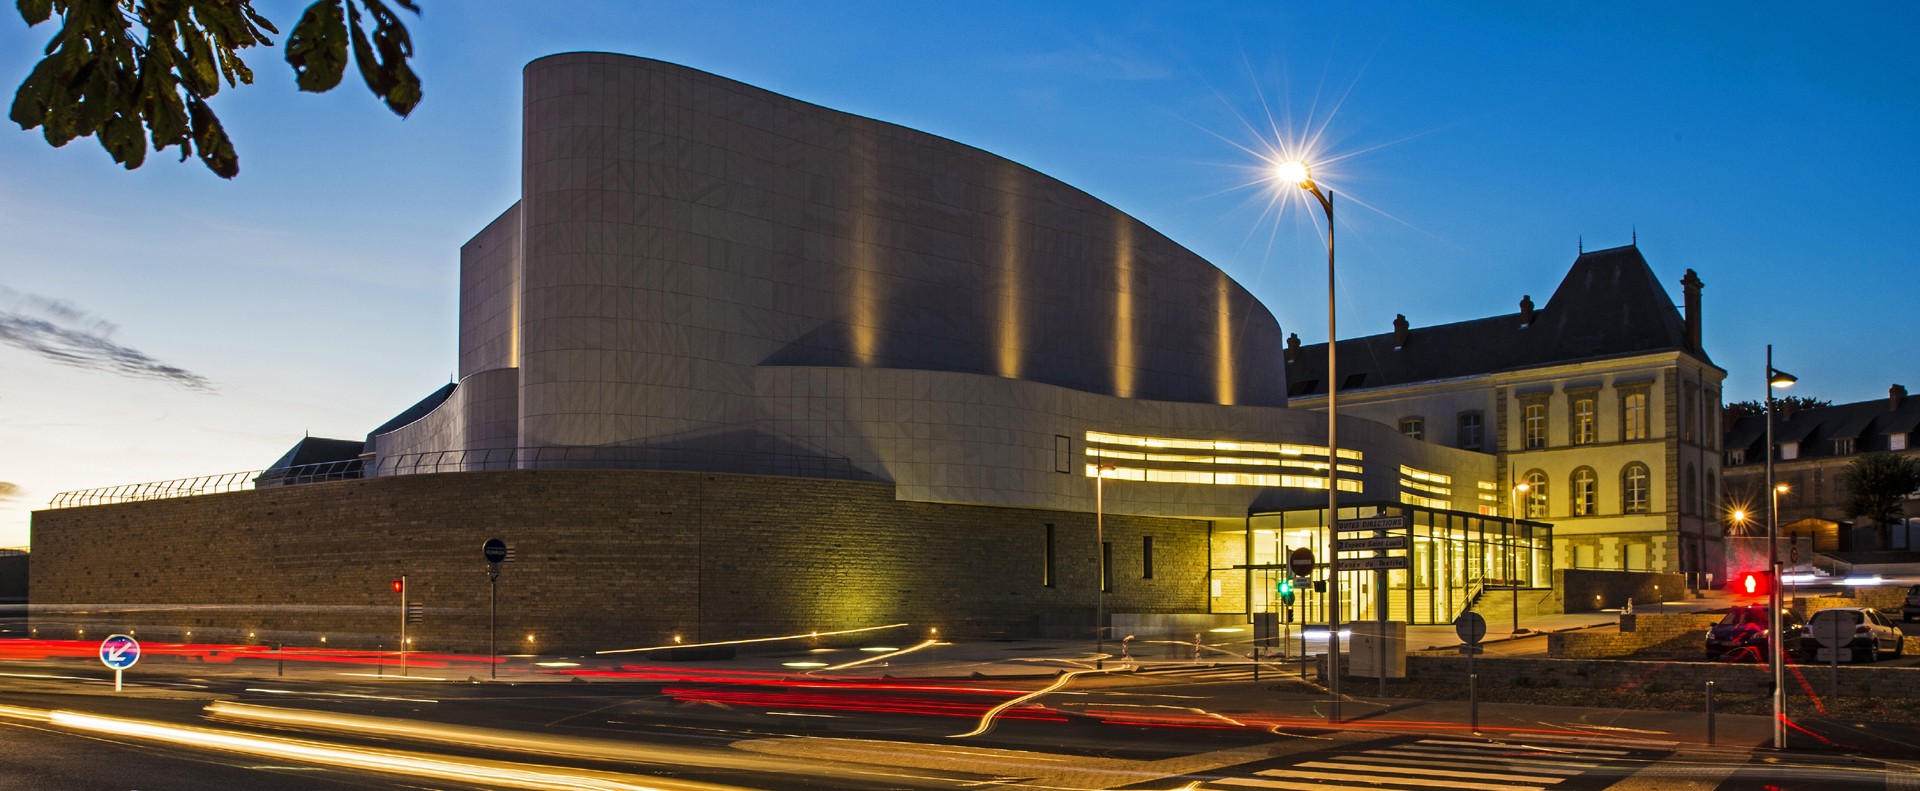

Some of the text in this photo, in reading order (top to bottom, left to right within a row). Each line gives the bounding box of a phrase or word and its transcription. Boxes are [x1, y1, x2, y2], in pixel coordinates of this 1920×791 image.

[1338, 519, 1402, 529] OUTES DIRECTIONS
[1345, 541, 1365, 549] Espace
[1379, 559, 1402, 567] Textile
